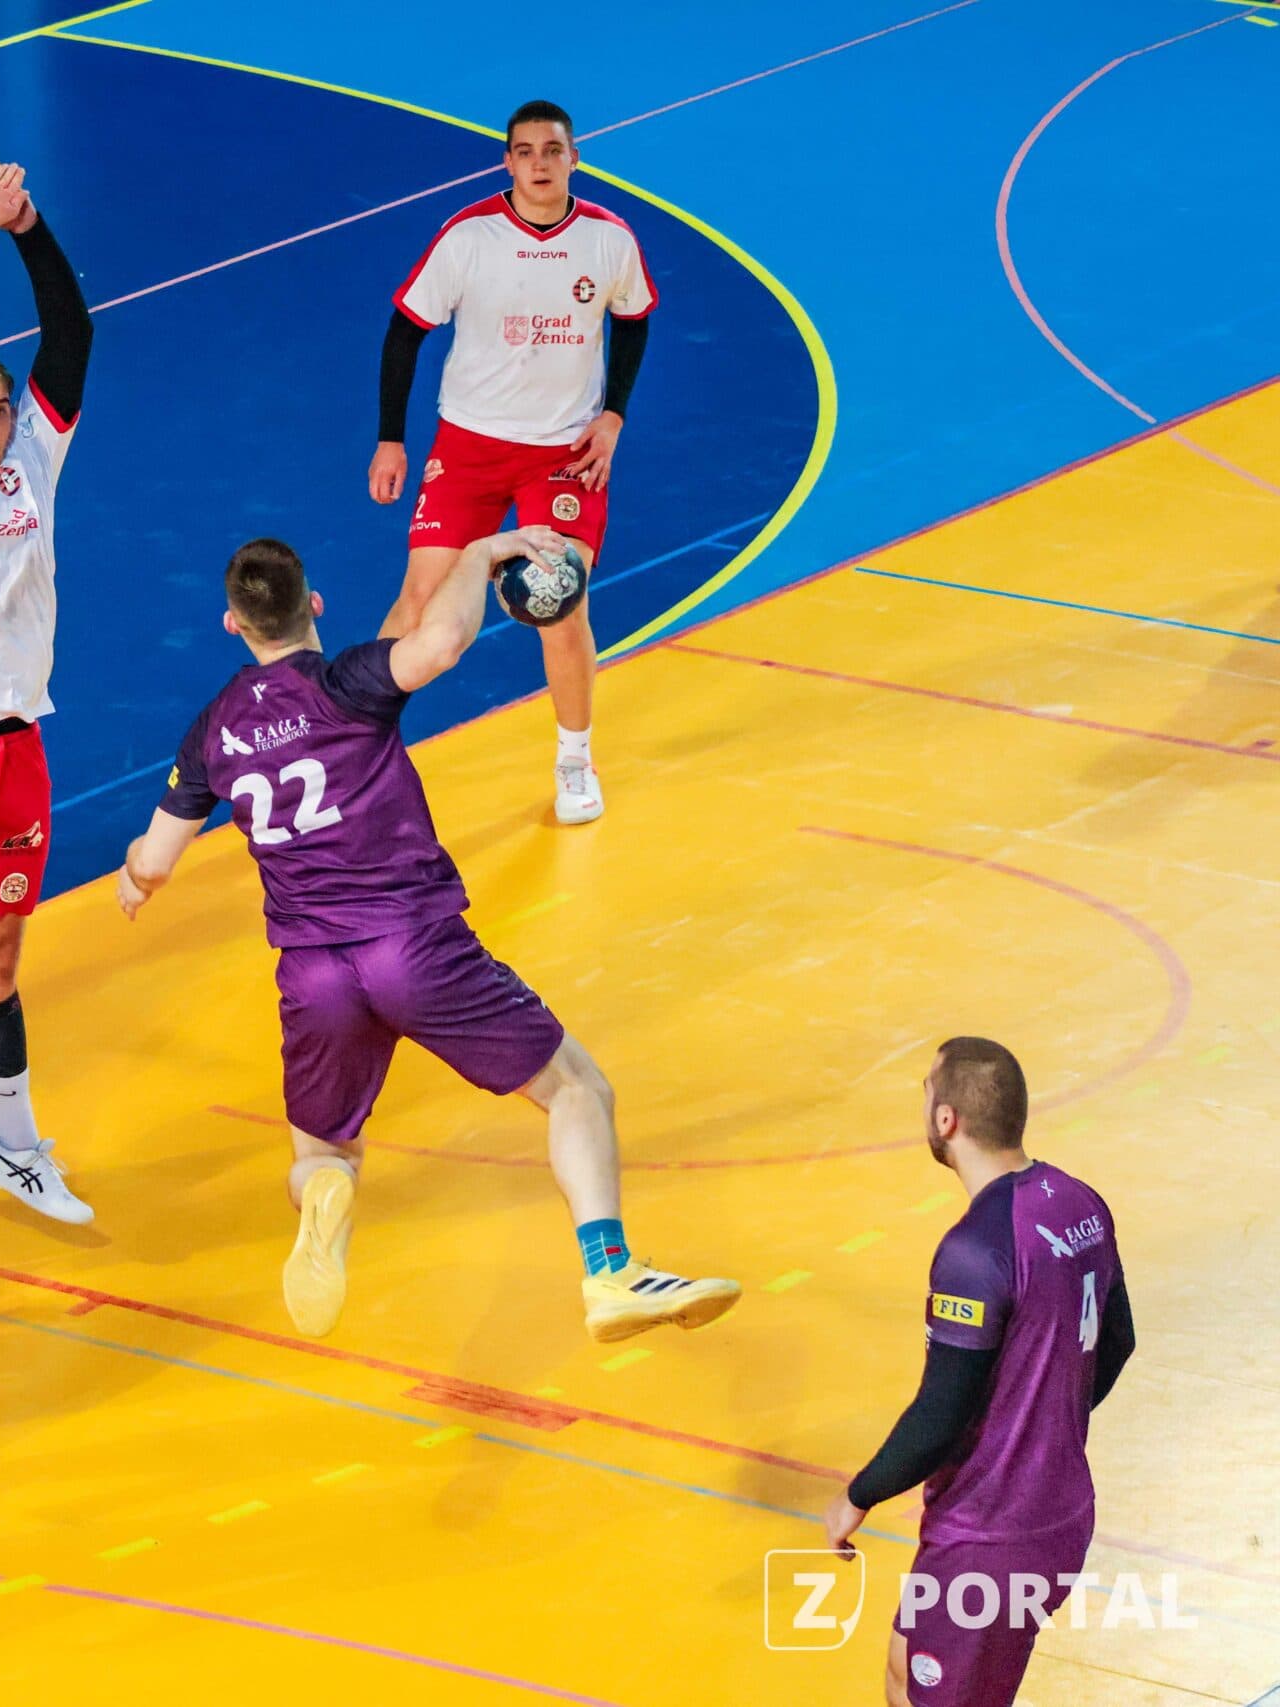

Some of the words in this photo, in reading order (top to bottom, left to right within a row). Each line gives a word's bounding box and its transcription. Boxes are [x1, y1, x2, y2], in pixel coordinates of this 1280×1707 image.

[517, 250, 568, 260] GIVOVA
[531, 314, 571, 329] Grad
[531, 331, 584, 345] Zenica
[415, 493, 426, 519] 2
[253, 713, 311, 743] EAGLE
[255, 726, 311, 753] TECHNOLOGY
[230, 758, 343, 845] 22
[1065, 1215, 1104, 1244] EAGLE
[939, 1299, 973, 1319] FIS
